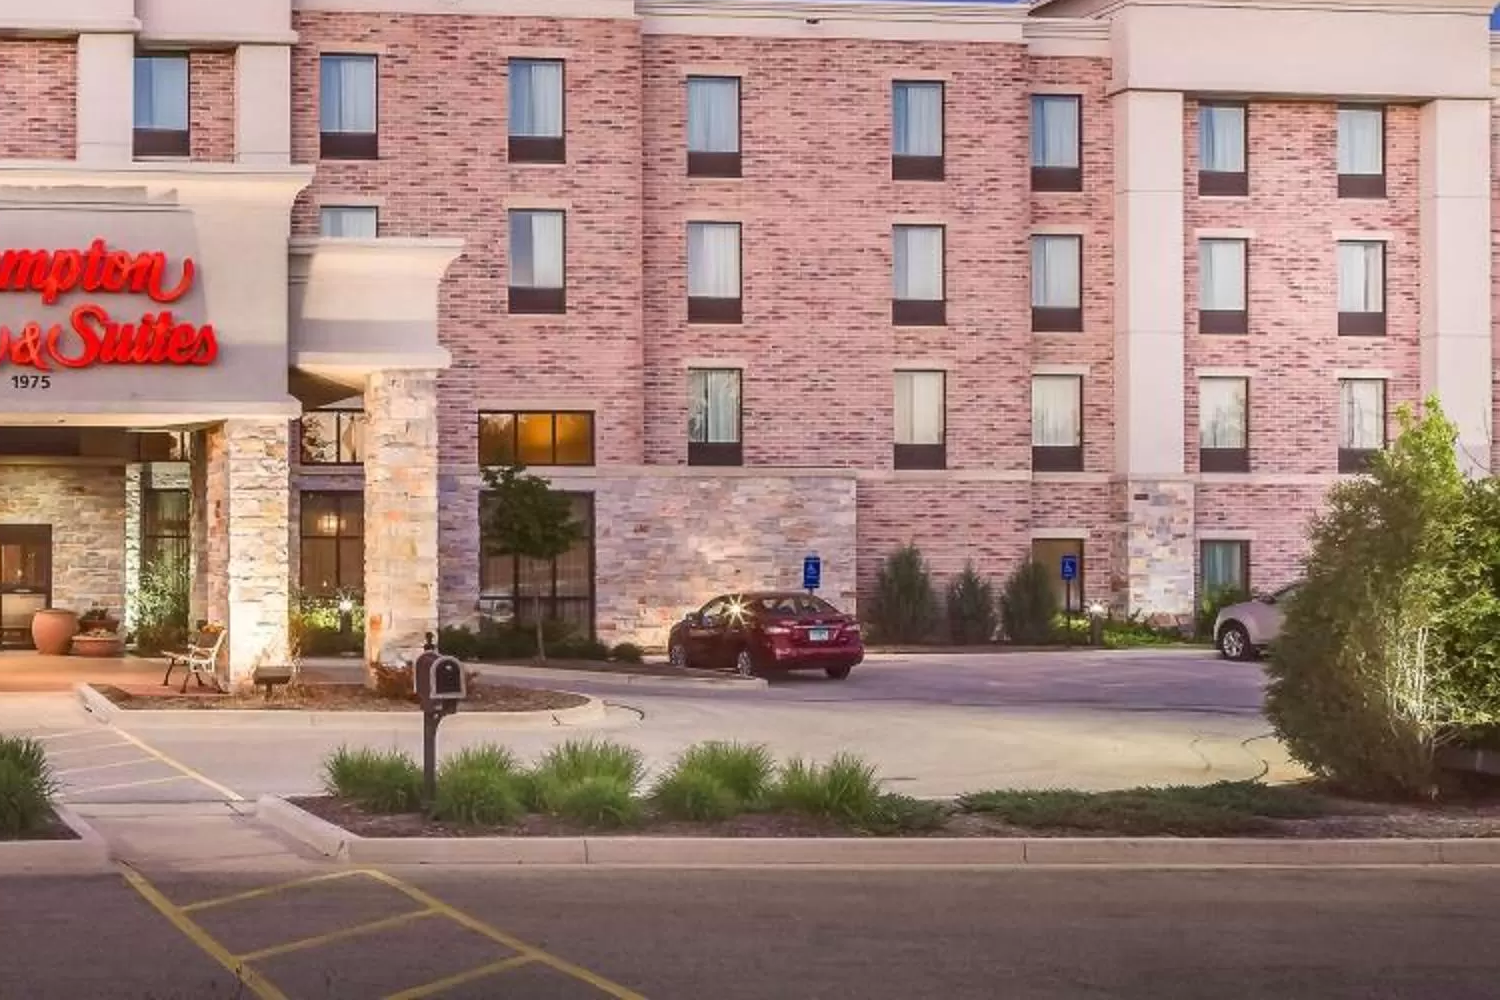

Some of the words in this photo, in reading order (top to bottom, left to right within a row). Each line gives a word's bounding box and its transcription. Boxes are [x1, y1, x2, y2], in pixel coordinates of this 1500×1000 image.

[11, 322, 51, 371] &
[48, 304, 219, 368] Suites
[11, 375, 51, 389] 1975
